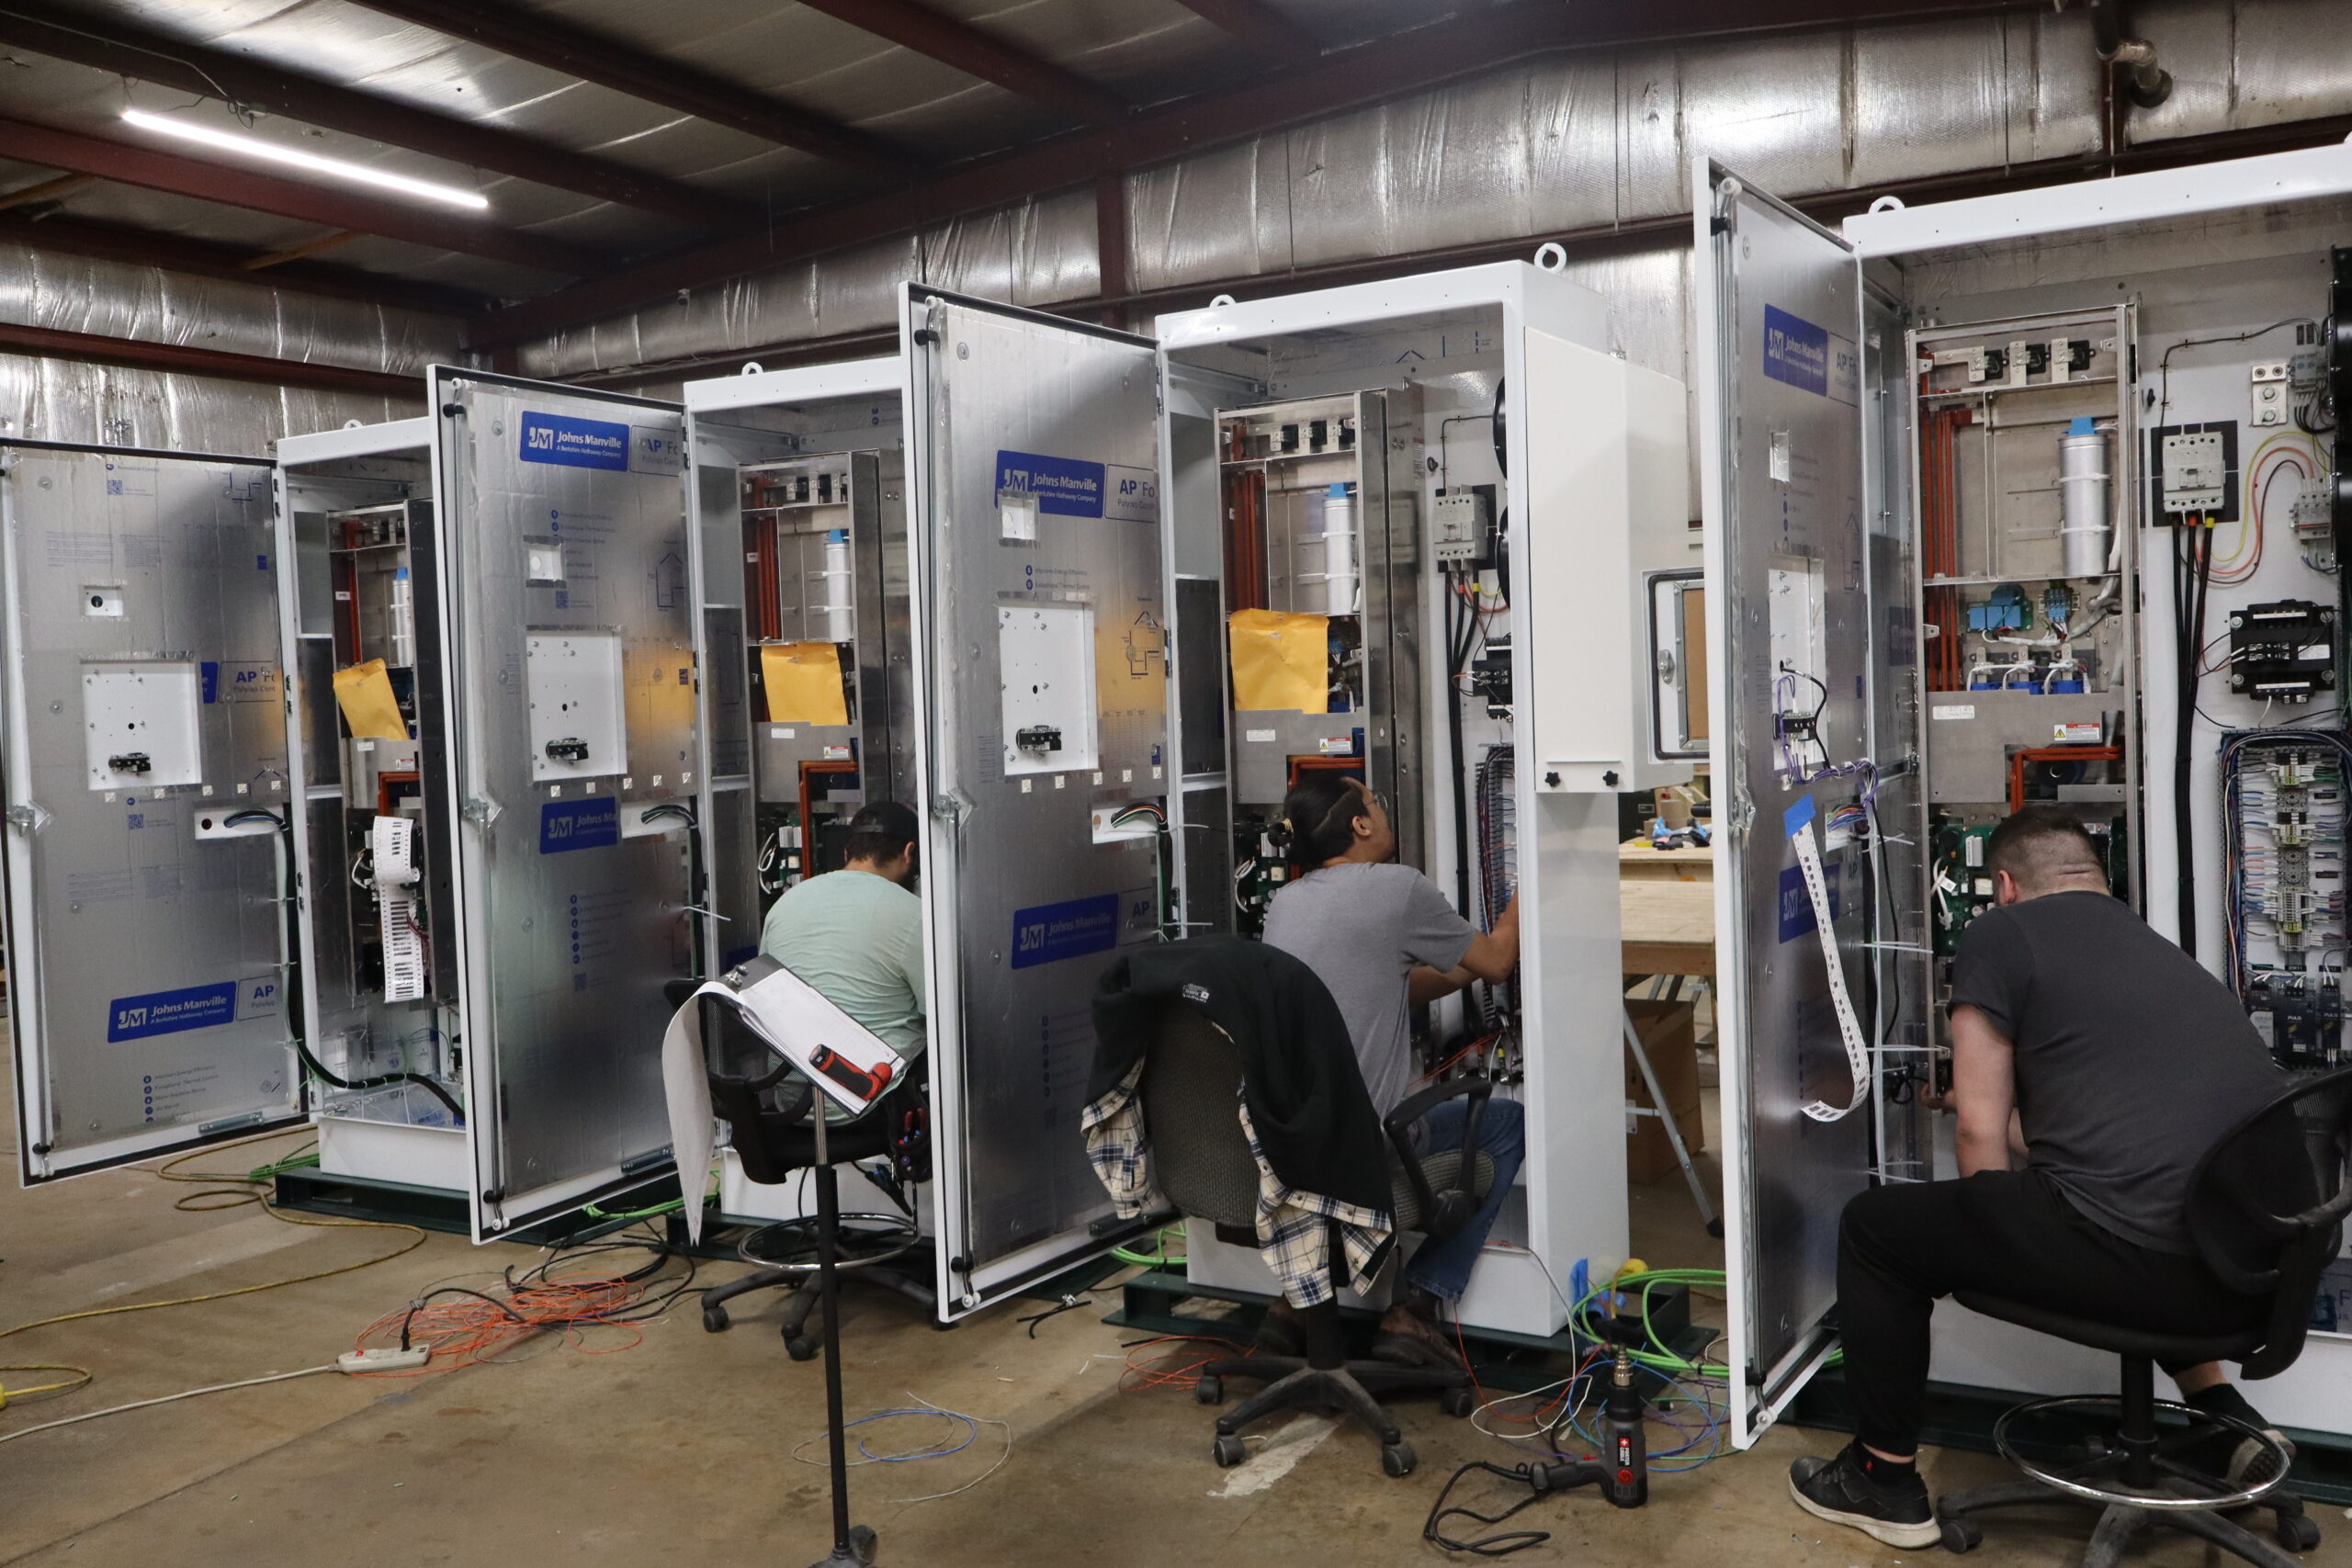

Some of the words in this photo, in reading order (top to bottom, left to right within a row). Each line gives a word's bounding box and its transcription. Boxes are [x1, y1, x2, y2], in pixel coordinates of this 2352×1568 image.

[1768, 327, 1785, 361] JM
[1785, 334, 1801, 354] Johns
[1802, 341, 1824, 363] Manville
[1836, 352, 1847, 372] AP
[528, 426, 554, 450] JM
[557, 430, 584, 445] Johns
[584, 434, 622, 448] Manville
[1003, 468, 1029, 492] JM
[1031, 472, 1059, 487] Johns
[1059, 475, 1098, 491] Manville
[1119, 479, 1137, 495] AP
[1077, 493, 1097, 503] Company
[235, 671, 257, 683] AP
[575, 814, 603, 828] Johns
[1132, 900, 1149, 918] AP
[1020, 923, 1046, 952] JM
[1047, 919, 1074, 937] Johns
[253, 985, 274, 999] AP
[150, 1004, 182, 1018] Johns
[183, 996, 227, 1010] Manville
[118, 1007, 147, 1030] JM
